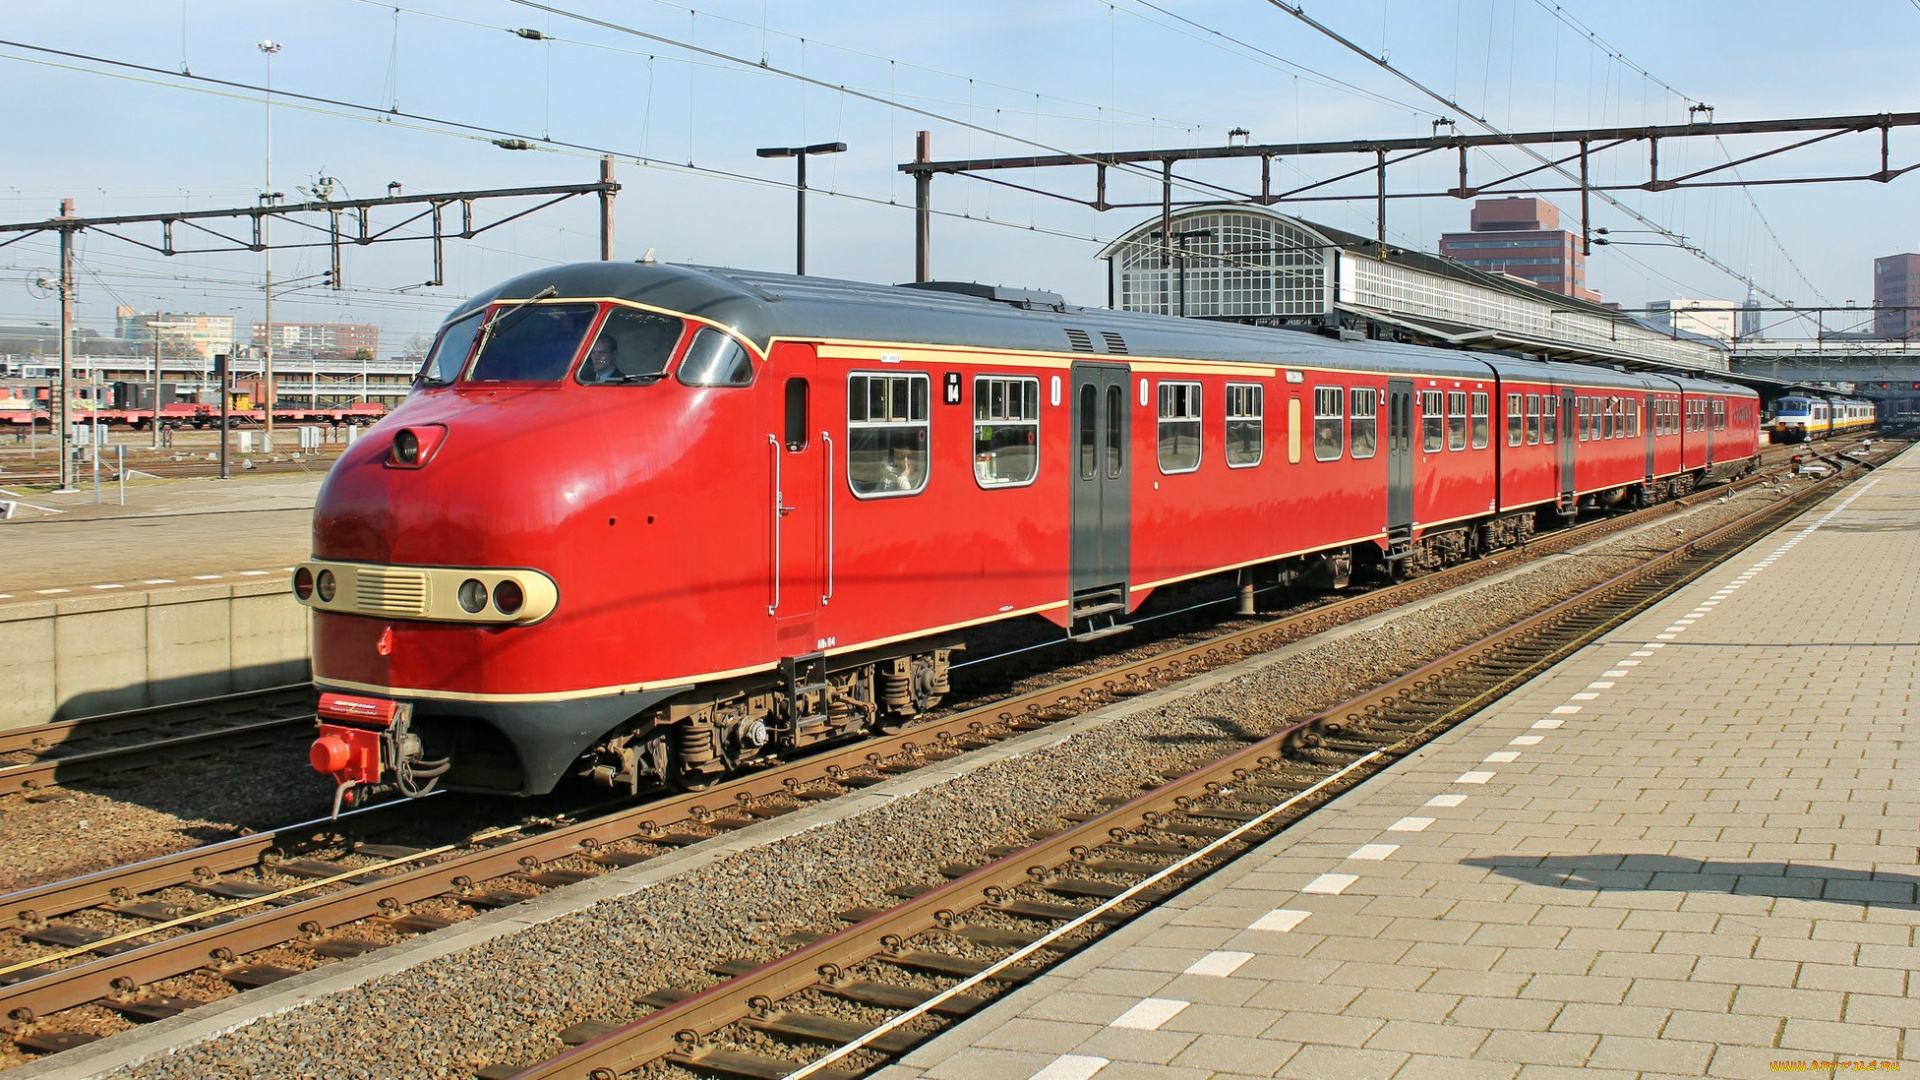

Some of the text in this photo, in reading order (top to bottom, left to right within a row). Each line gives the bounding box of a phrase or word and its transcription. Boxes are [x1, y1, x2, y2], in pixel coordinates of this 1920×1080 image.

[947, 384, 959, 402] 114
[1380, 388, 1385, 406] 2
[1416, 389, 1421, 406] 2
